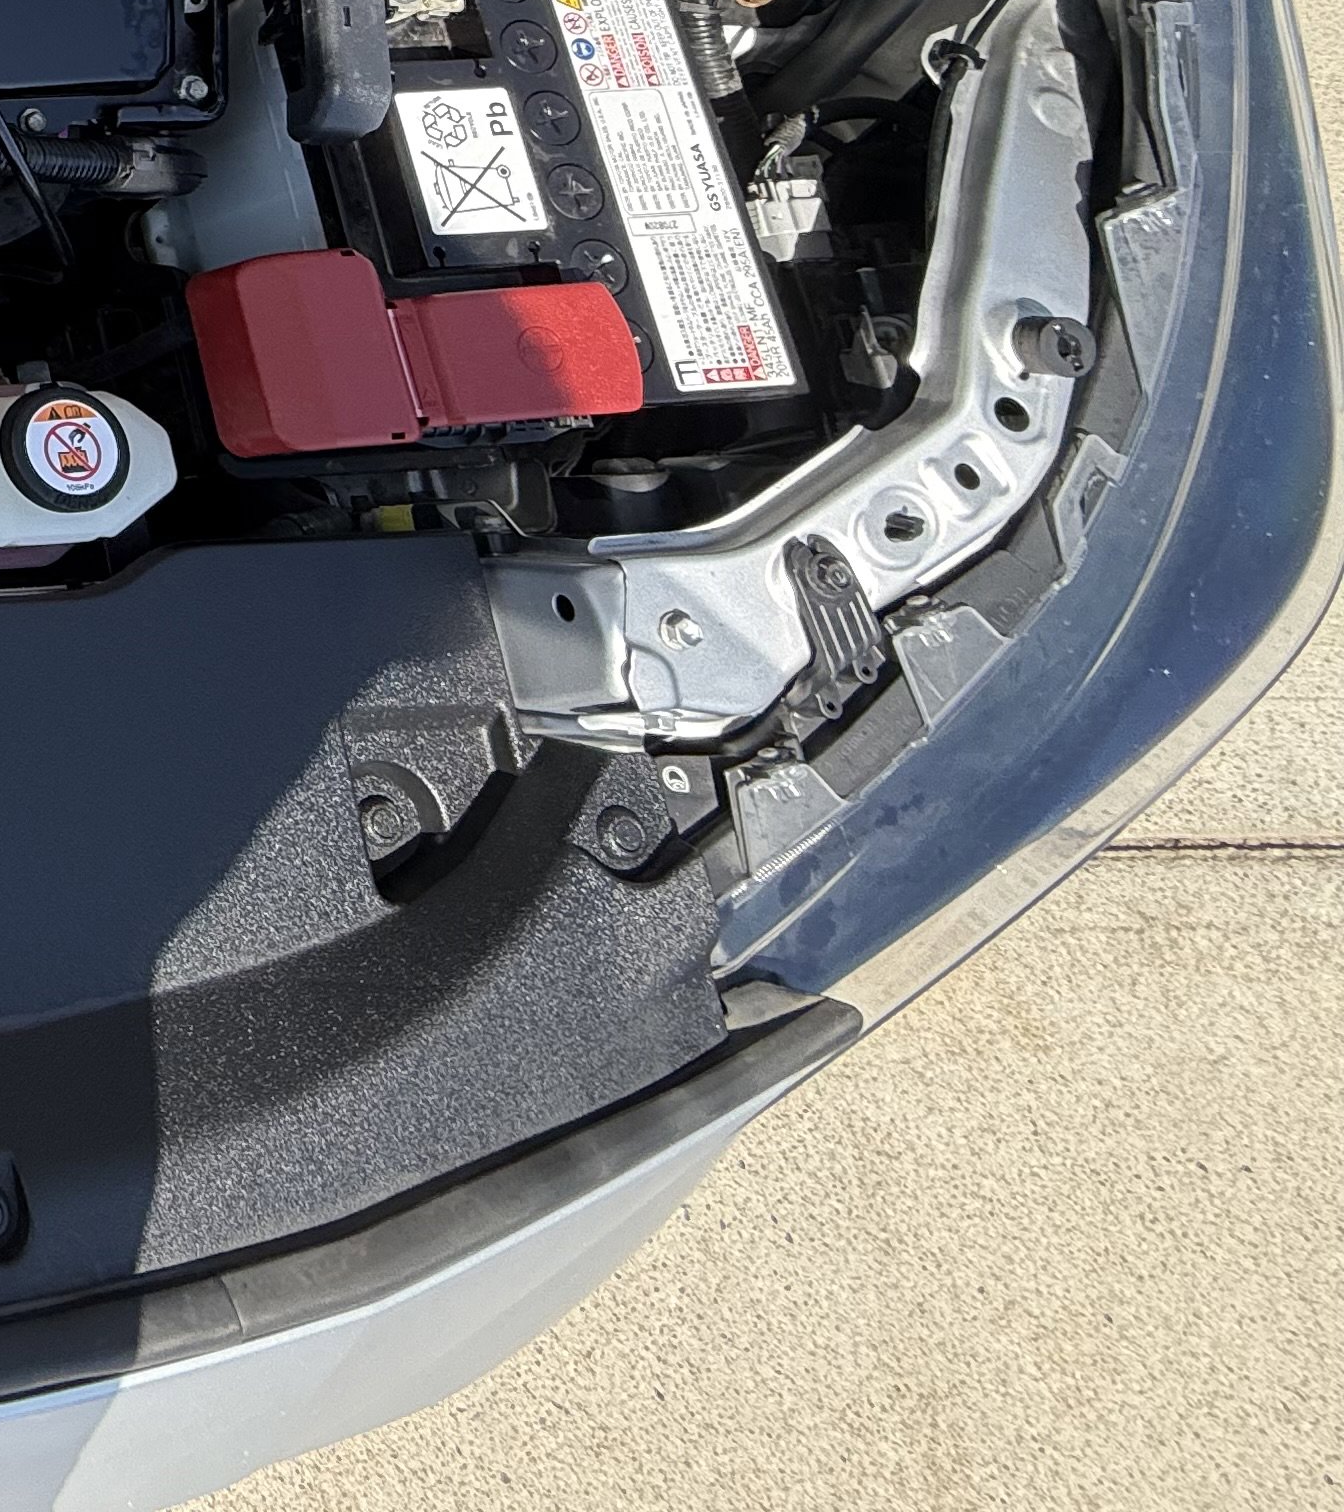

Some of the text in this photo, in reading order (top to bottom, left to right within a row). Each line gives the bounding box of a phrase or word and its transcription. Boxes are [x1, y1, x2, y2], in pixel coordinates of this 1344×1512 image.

[601, 34, 627, 76] DANGER
[631, 33, 657, 74] POISON
[485, 101, 514, 136] Pb
[689, 142, 716, 192] YUASA
[705, 192, 723, 212] GS
[749, 281, 765, 307] CCA
[759, 313, 778, 342] 45Ah
[739, 326, 761, 366] DANGER
[771, 345, 790, 377] 20HR
